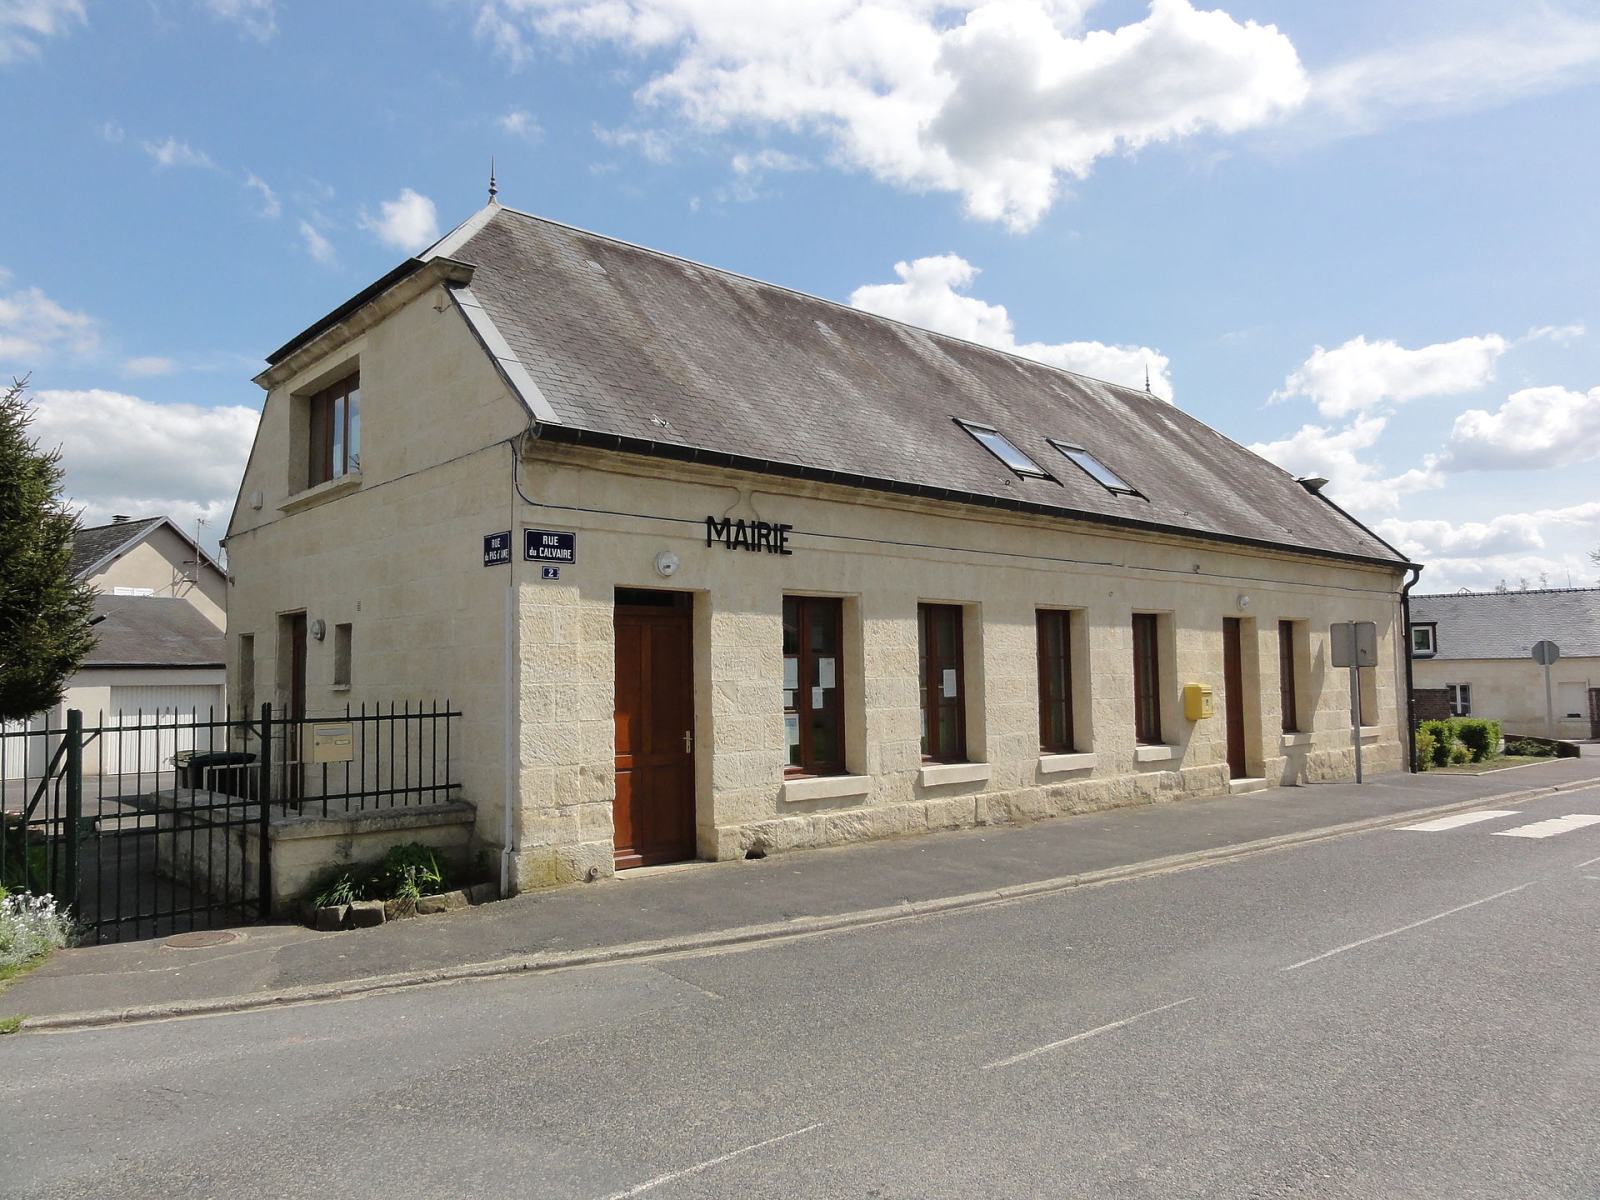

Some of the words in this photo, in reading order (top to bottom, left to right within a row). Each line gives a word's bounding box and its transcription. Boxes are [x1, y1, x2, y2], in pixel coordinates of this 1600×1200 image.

[543, 535, 559, 546] RUE
[707, 516, 793, 555] MAIRIE
[491, 538, 501, 548] RUE
[529, 547, 537, 556] du
[539, 547, 572, 559] CALVAIRE
[548, 569, 554, 577] 2
